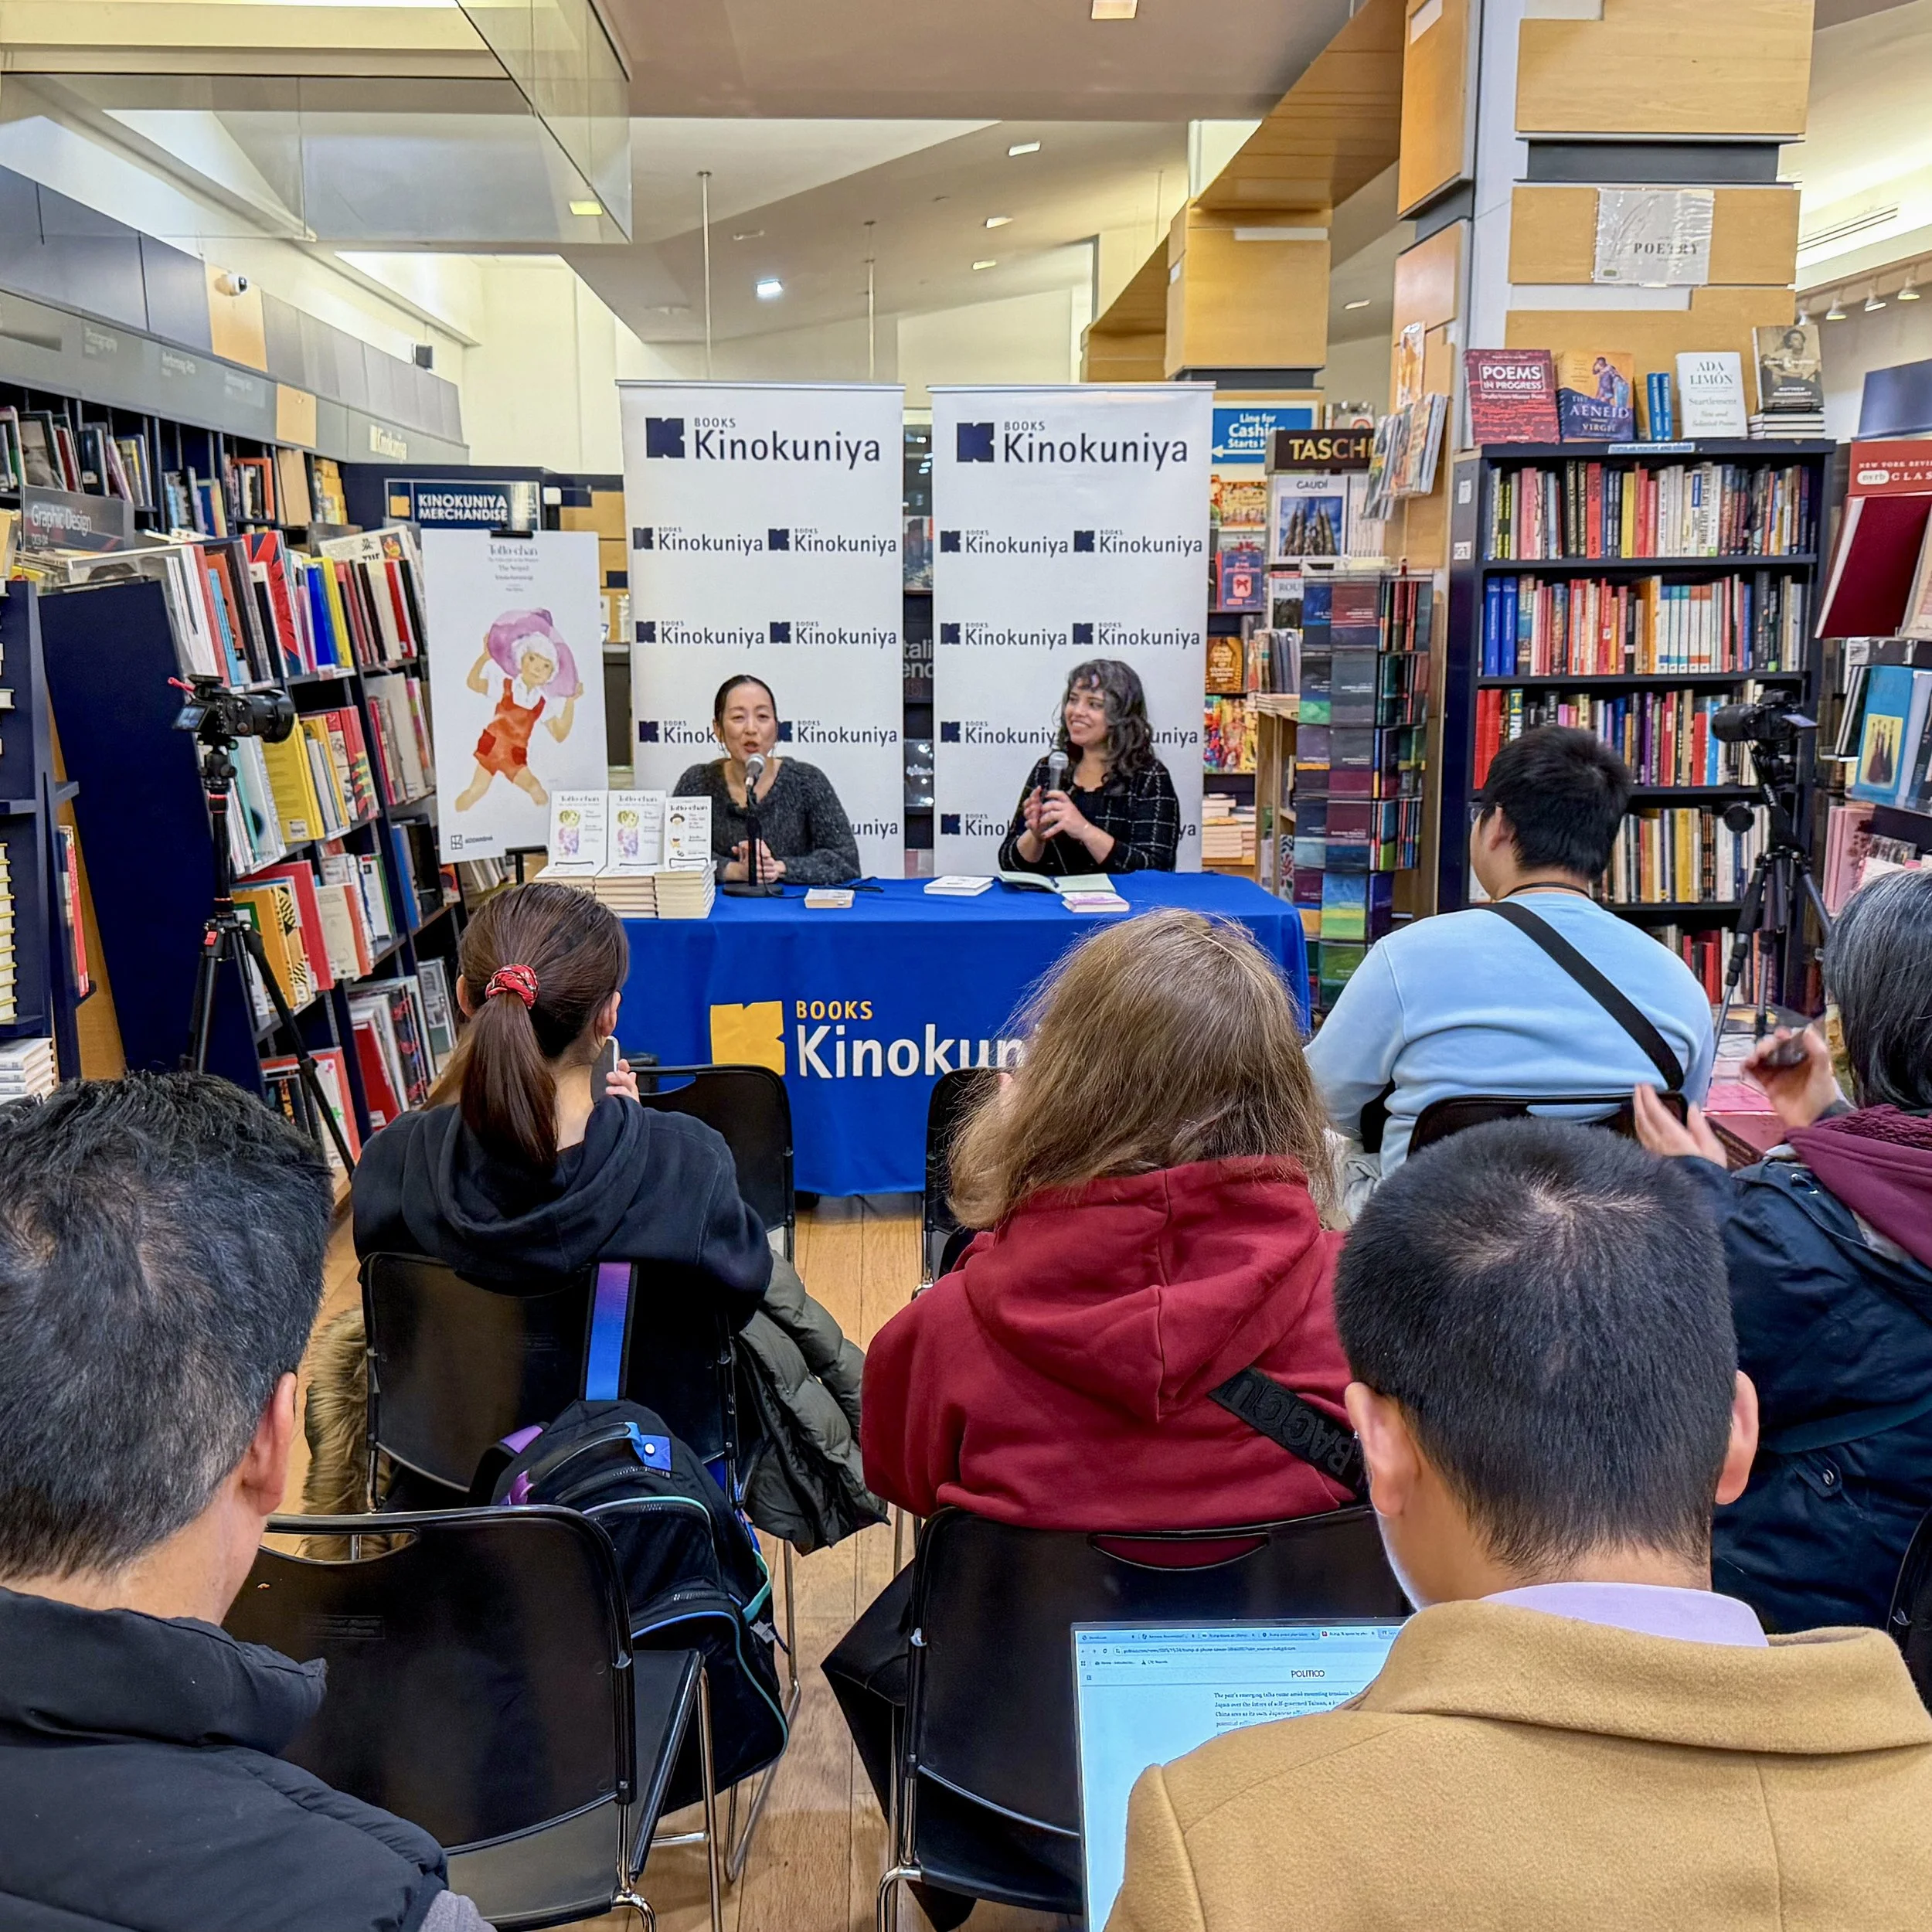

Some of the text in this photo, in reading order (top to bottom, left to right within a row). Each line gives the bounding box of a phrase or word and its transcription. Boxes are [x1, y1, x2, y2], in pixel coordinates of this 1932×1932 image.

[1634, 243, 1698, 255] POETRY
[1482, 366, 1541, 379] POEMS
[1696, 361, 1724, 372] ADA
[1690, 372, 1733, 385] LIMÓN
[1240, 413, 1277, 423] Line for
[1570, 404, 1629, 418] AENEID
[694, 418, 736, 428] BOOKS
[1004, 421, 1045, 430] BOOKS
[695, 430, 880, 470] Kinokuniya
[1005, 433, 1188, 471] Kinokuniya
[1228, 439, 1258, 448] Starts
[1297, 479, 1328, 489] GAUDÍ
[418, 494, 508, 509] KINOKUNIYA
[32, 505, 92, 537] Graphic Design
[418, 509, 508, 522] MERCHANDISE
[658, 534, 763, 556] Kinokuniya
[794, 535, 896, 556] Kinokuniya
[966, 536, 1068, 557] Kinokuniya
[1100, 536, 1202, 557] Kinokuniya
[661, 628, 764, 648] Kinokuniya
[795, 628, 896, 649] Kinokuniya
[965, 629, 1067, 650] Kinokuniya
[1098, 629, 1200, 649] Kinokuniya
[664, 727, 716, 743] Kinok
[798, 727, 897, 747] Kinokuniya
[965, 728, 1056, 747] Kinokuniy
[1151, 729, 1198, 747] uniya
[852, 819, 898, 838] uniya
[796, 1001, 872, 1019] BOOKS
[798, 1023, 1025, 1078] Kinokun
[1291, 1670, 1325, 1679] POLITICO
